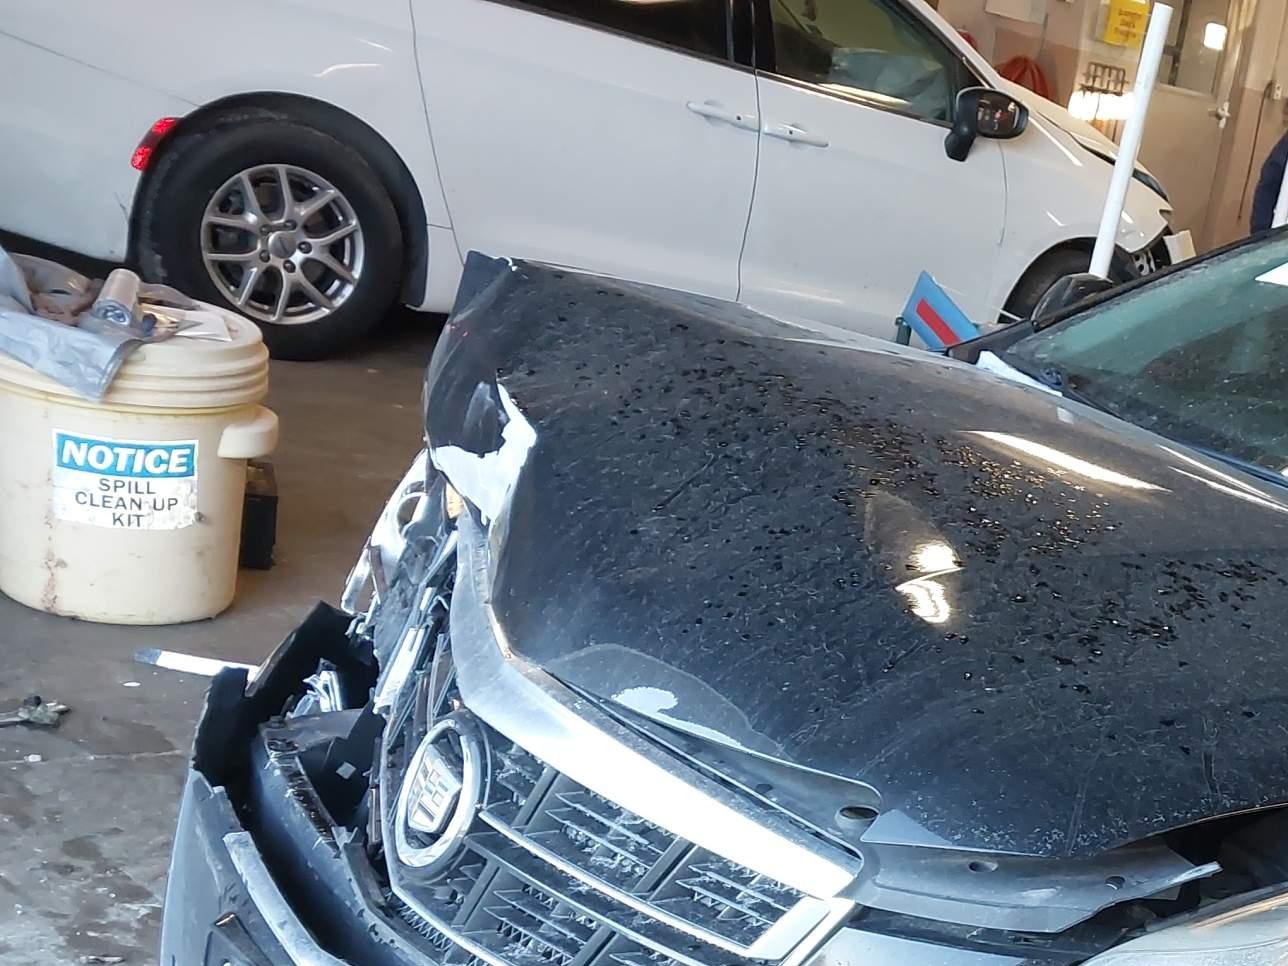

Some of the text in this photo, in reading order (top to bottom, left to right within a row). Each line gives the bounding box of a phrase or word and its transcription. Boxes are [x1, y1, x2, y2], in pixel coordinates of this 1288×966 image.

[61, 439, 191, 474] NOTICE
[99, 478, 156, 494] SPILL
[75, 491, 178, 511] CLEAN UP
[112, 512, 144, 527] KIT
